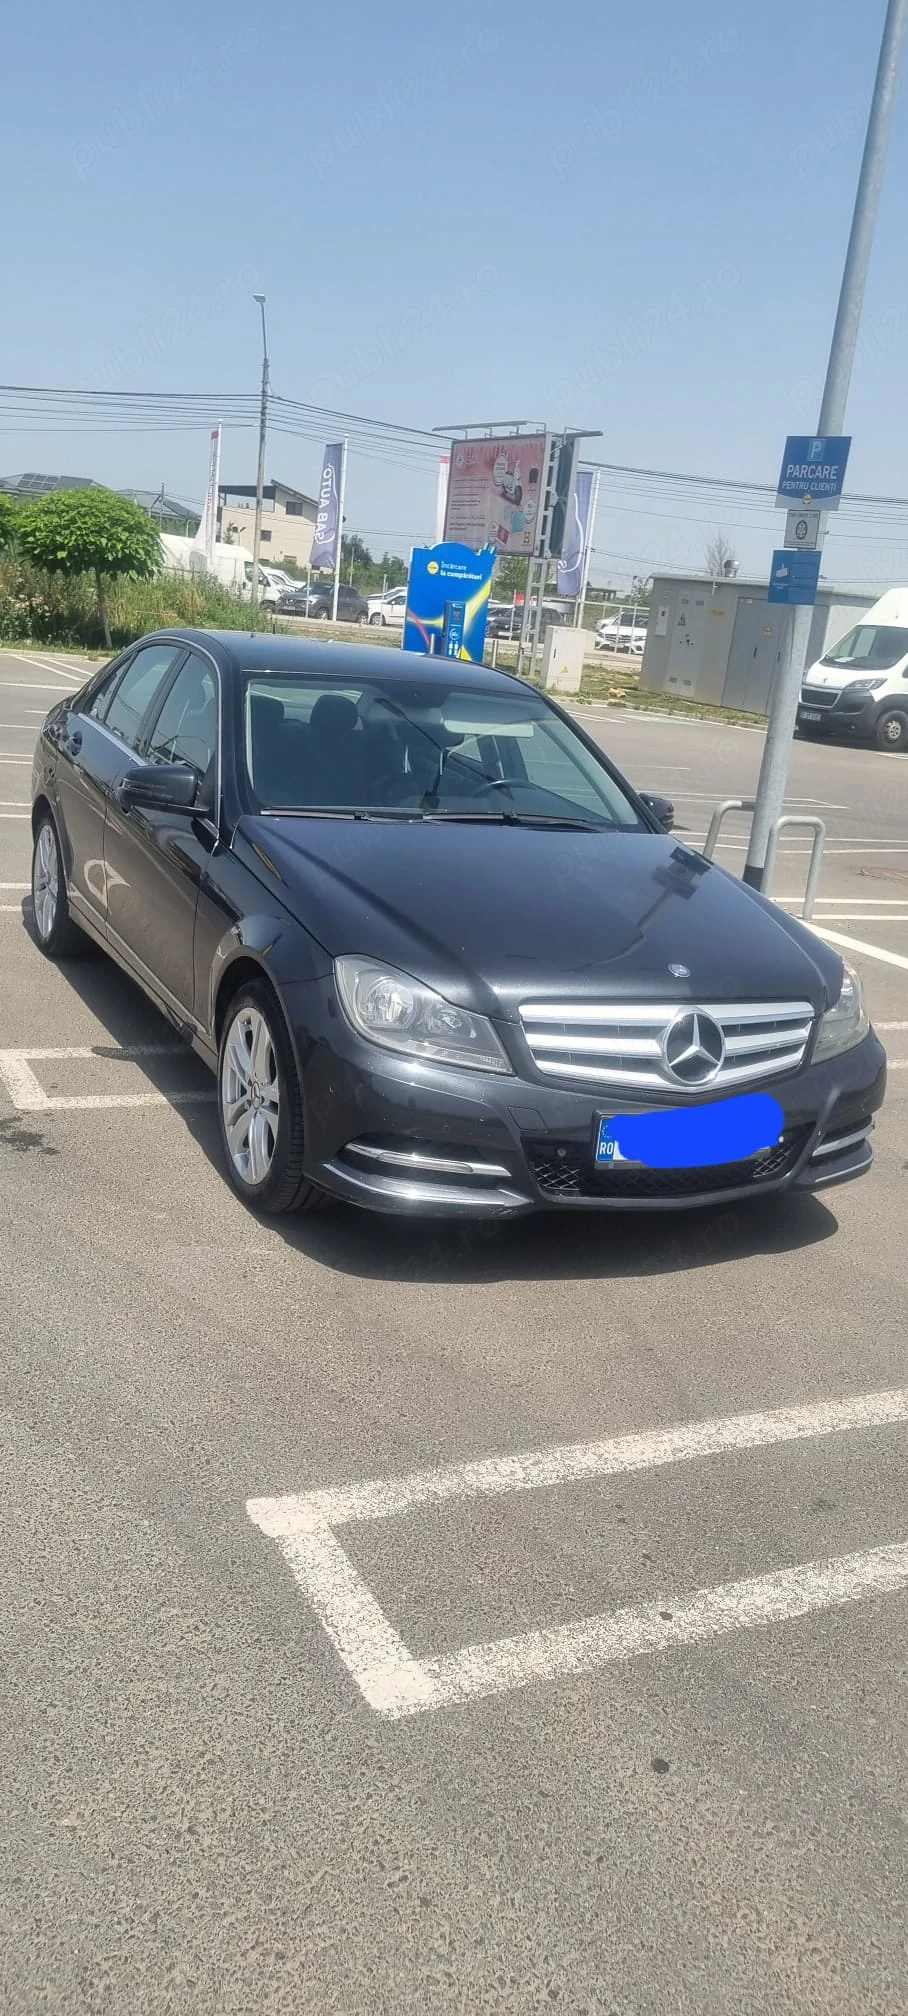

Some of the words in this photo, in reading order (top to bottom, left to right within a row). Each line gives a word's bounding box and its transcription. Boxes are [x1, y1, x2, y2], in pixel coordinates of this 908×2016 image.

[811, 440, 822, 458] P
[786, 464, 839, 479] PARCARE
[781, 480, 810, 491] PENTRU
[599, 1141, 614, 1156] RO
